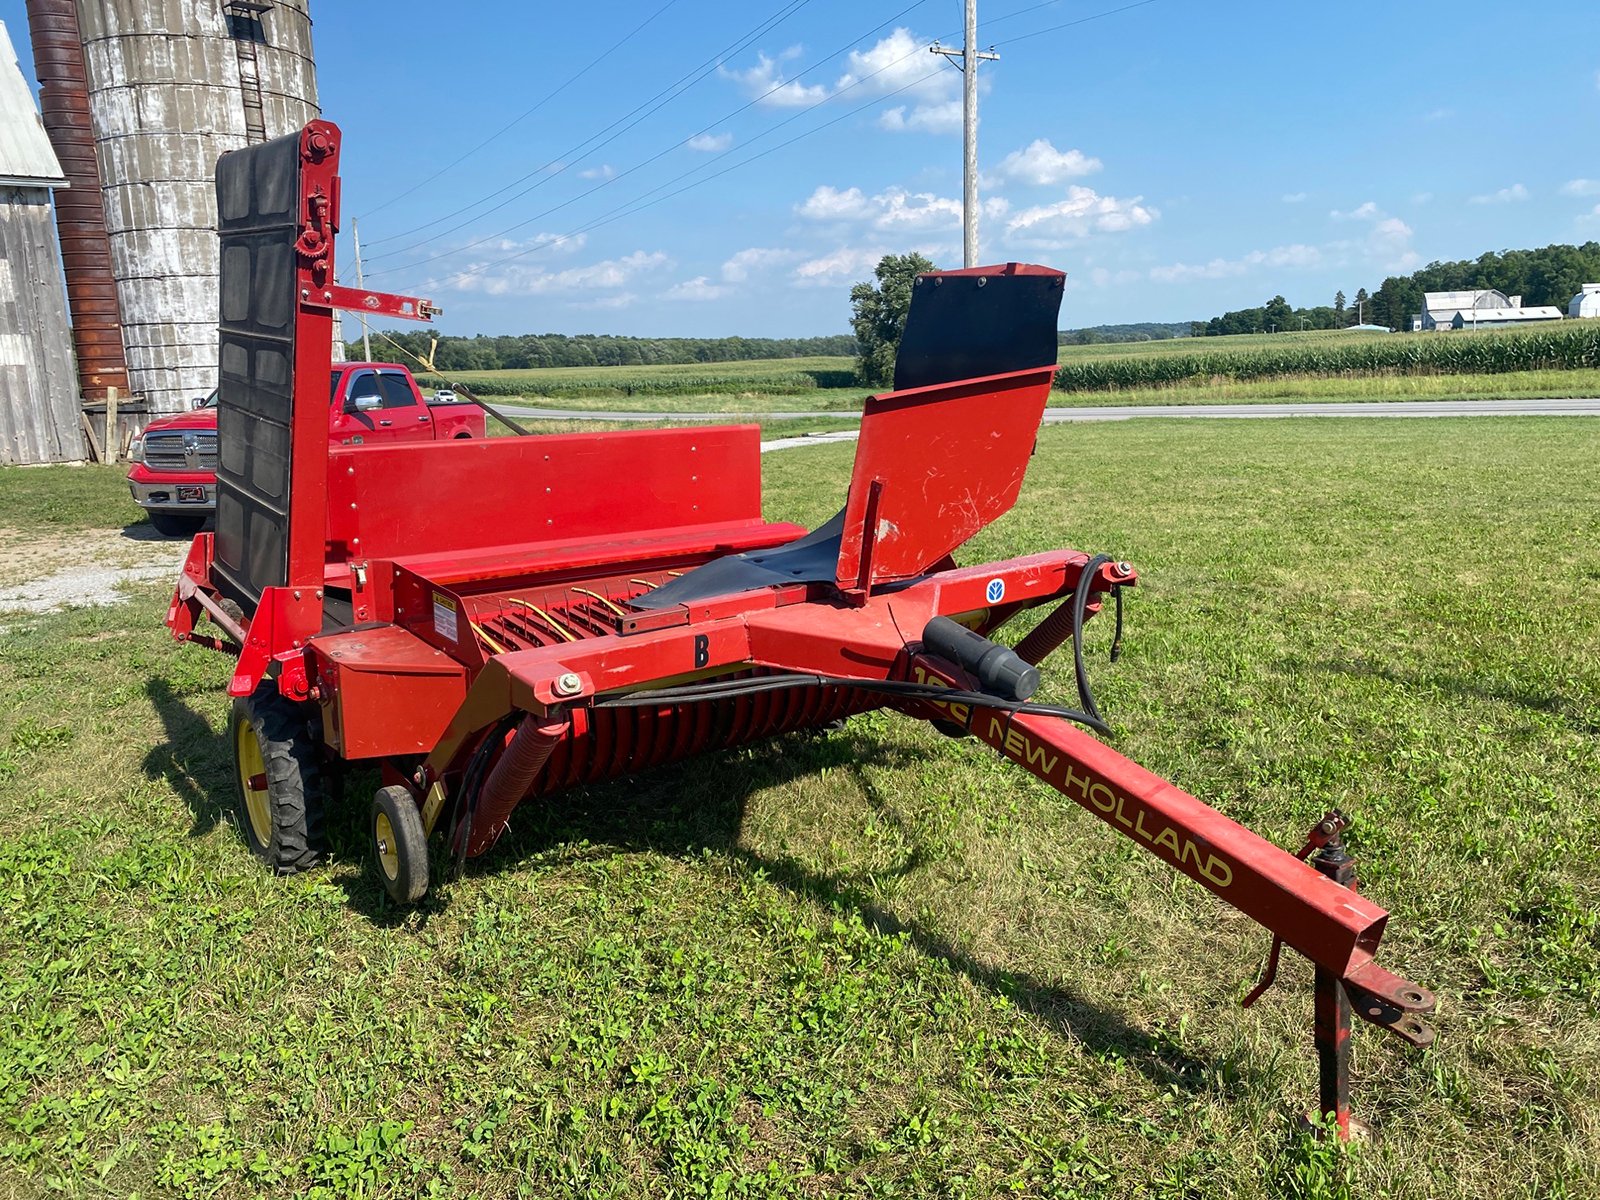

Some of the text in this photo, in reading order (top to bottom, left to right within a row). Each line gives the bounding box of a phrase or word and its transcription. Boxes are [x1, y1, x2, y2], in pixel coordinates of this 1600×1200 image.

[694, 634, 709, 669] B
[988, 717, 1058, 775] NEW
[1064, 765, 1233, 888] HOLLAND
